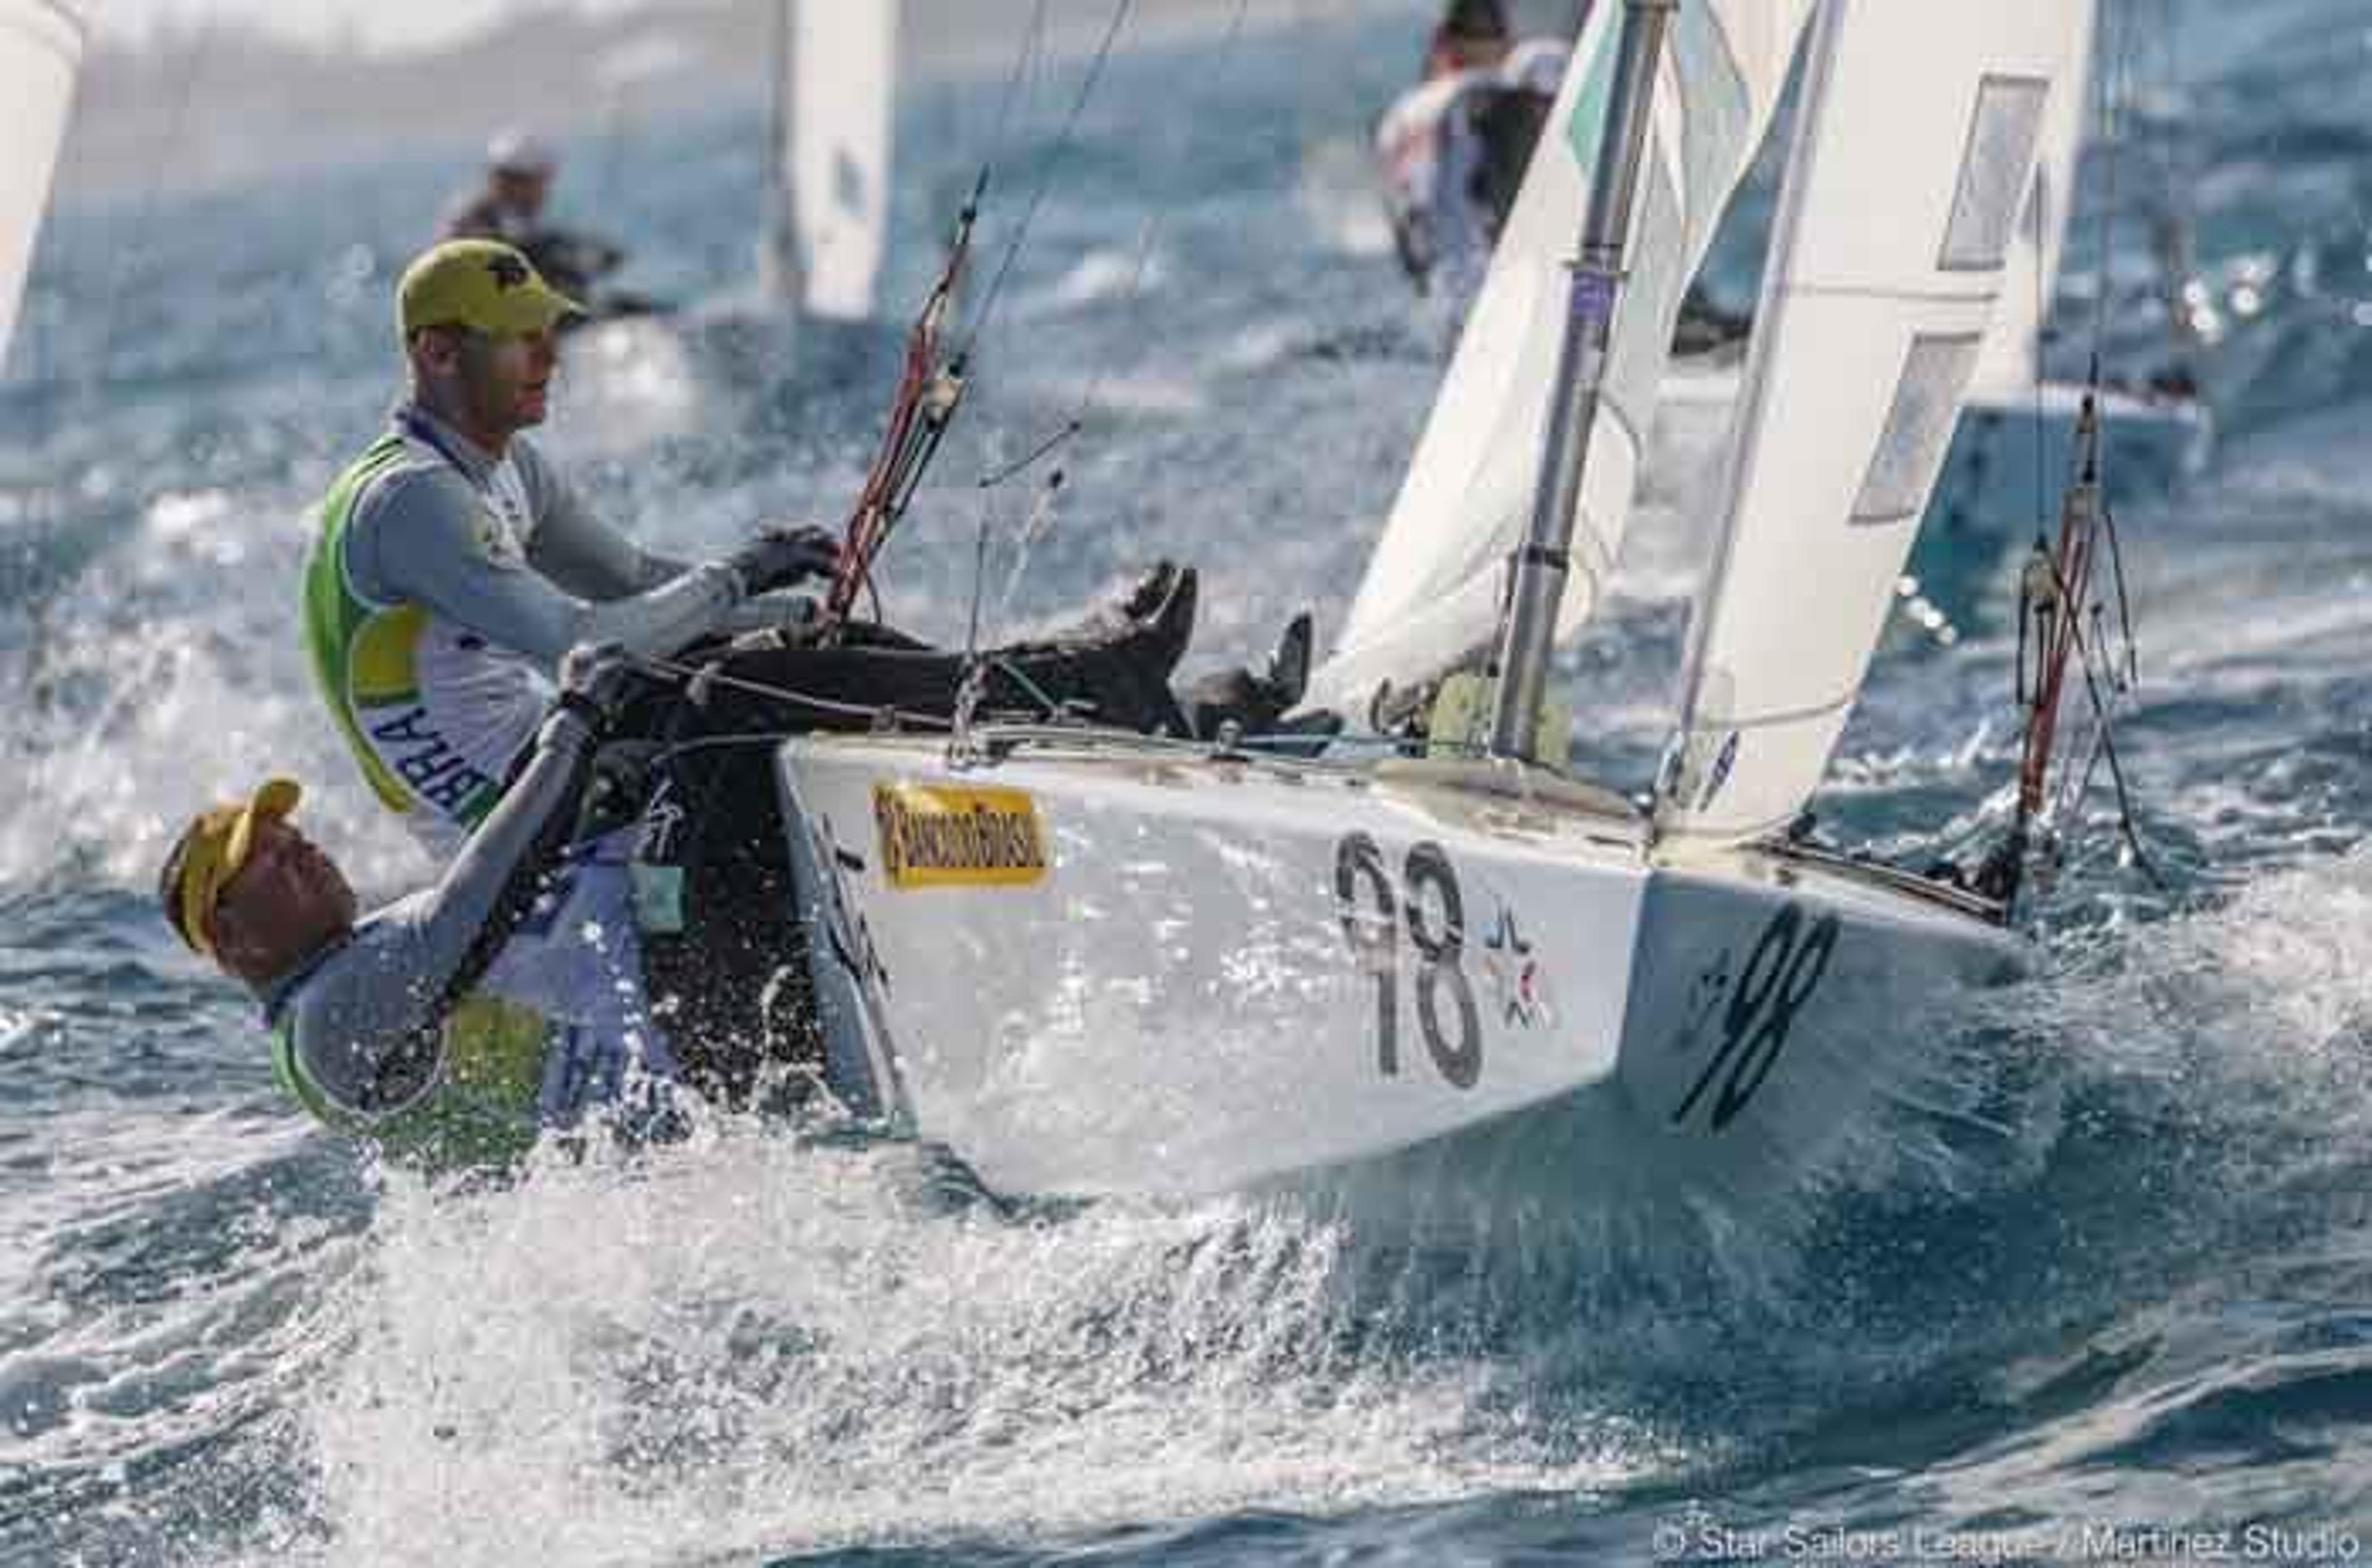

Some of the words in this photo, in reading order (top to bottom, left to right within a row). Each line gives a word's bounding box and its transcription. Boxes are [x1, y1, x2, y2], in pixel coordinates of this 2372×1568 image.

[373, 706, 488, 808] BRA
[1335, 831, 1482, 1091] 98
[1670, 903, 1842, 1130] 98
